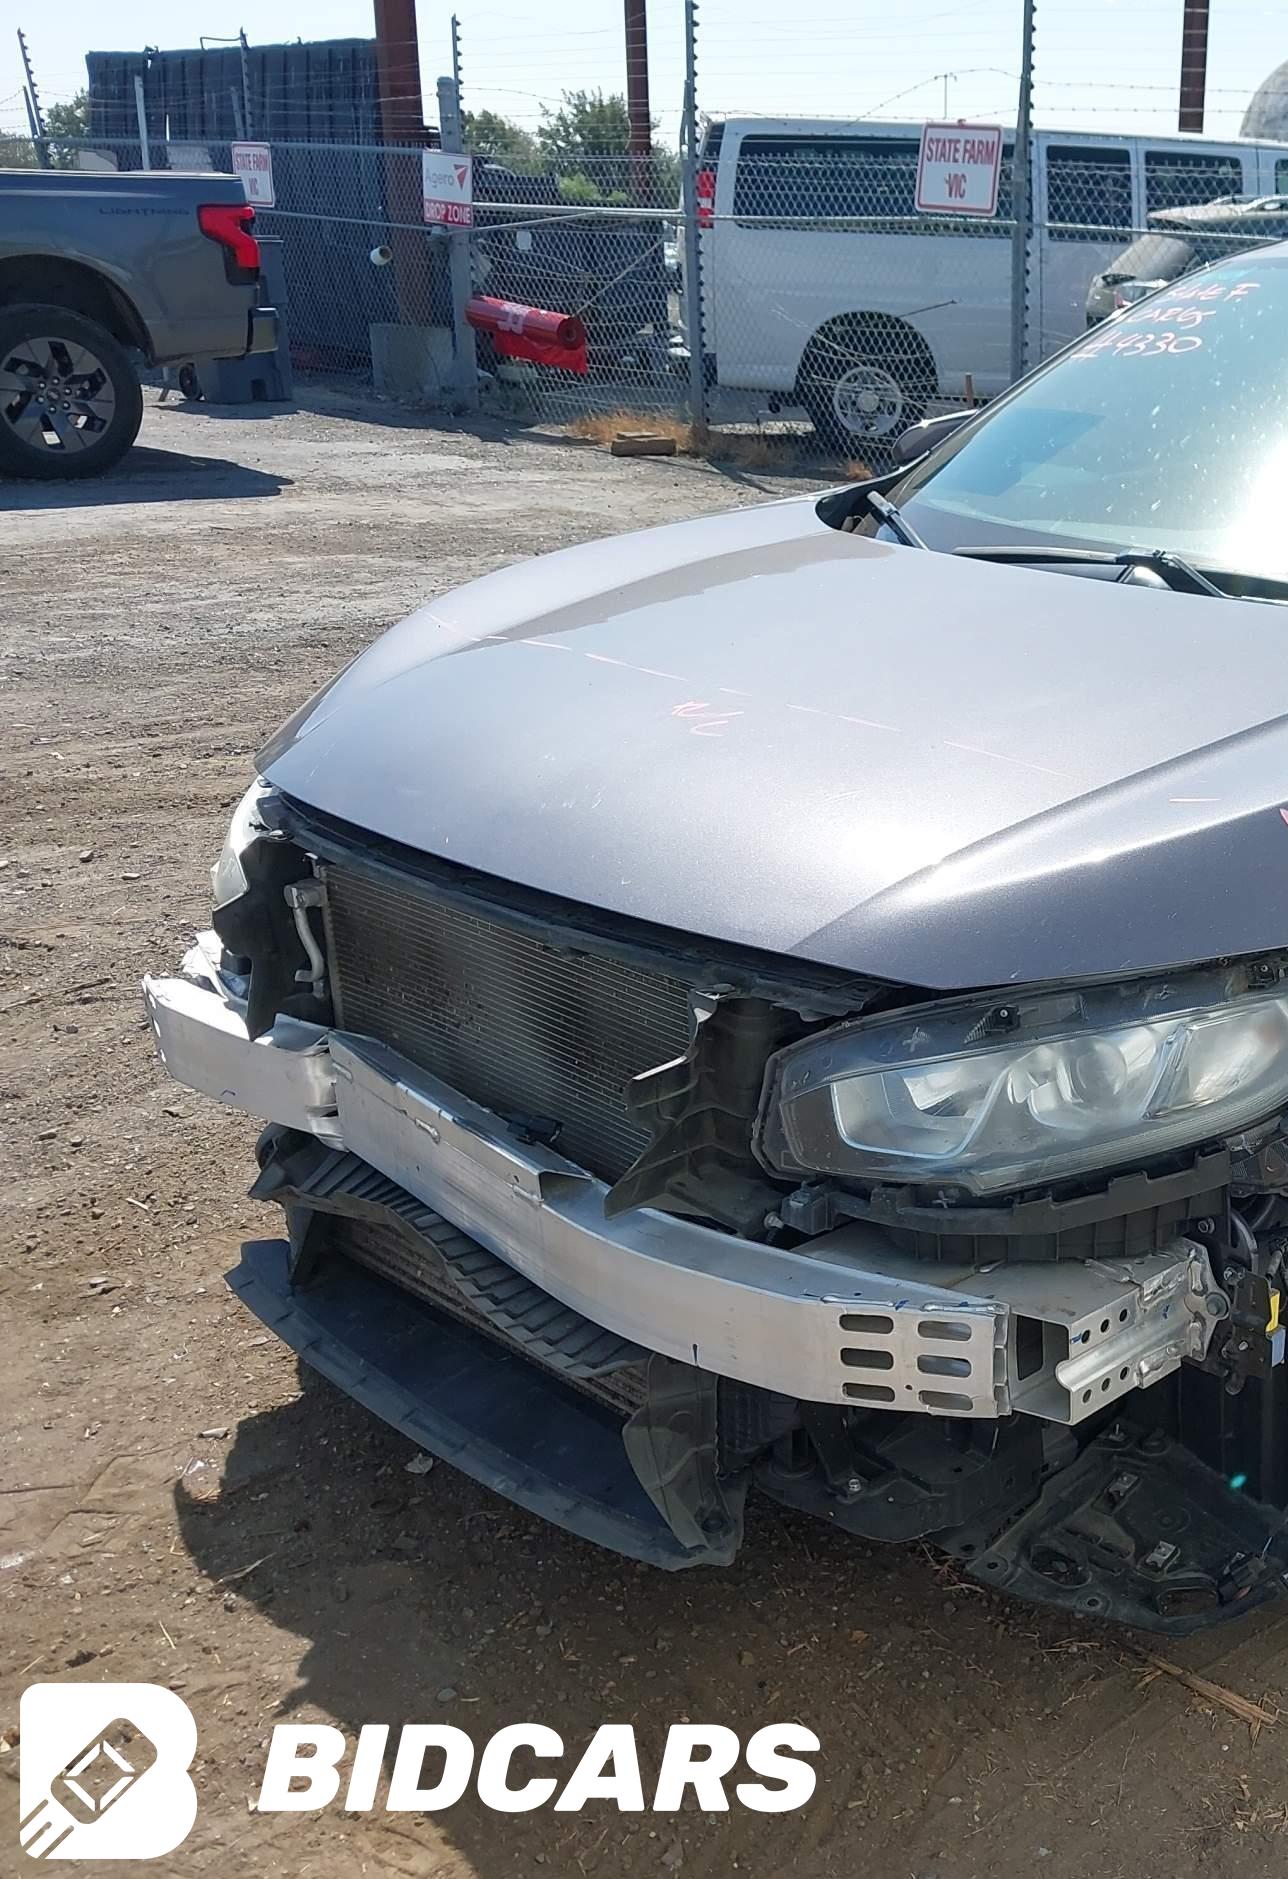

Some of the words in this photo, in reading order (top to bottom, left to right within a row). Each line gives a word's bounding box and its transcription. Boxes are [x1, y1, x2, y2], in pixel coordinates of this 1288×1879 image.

[234, 153, 252, 170] STATE
[253, 153, 269, 172] FARM
[926, 137, 961, 164] STATE
[962, 138, 996, 166] FARM
[947, 173, 967, 199] VIC
[425, 201, 446, 220] DROP
[447, 204, 471, 224] ZONE
